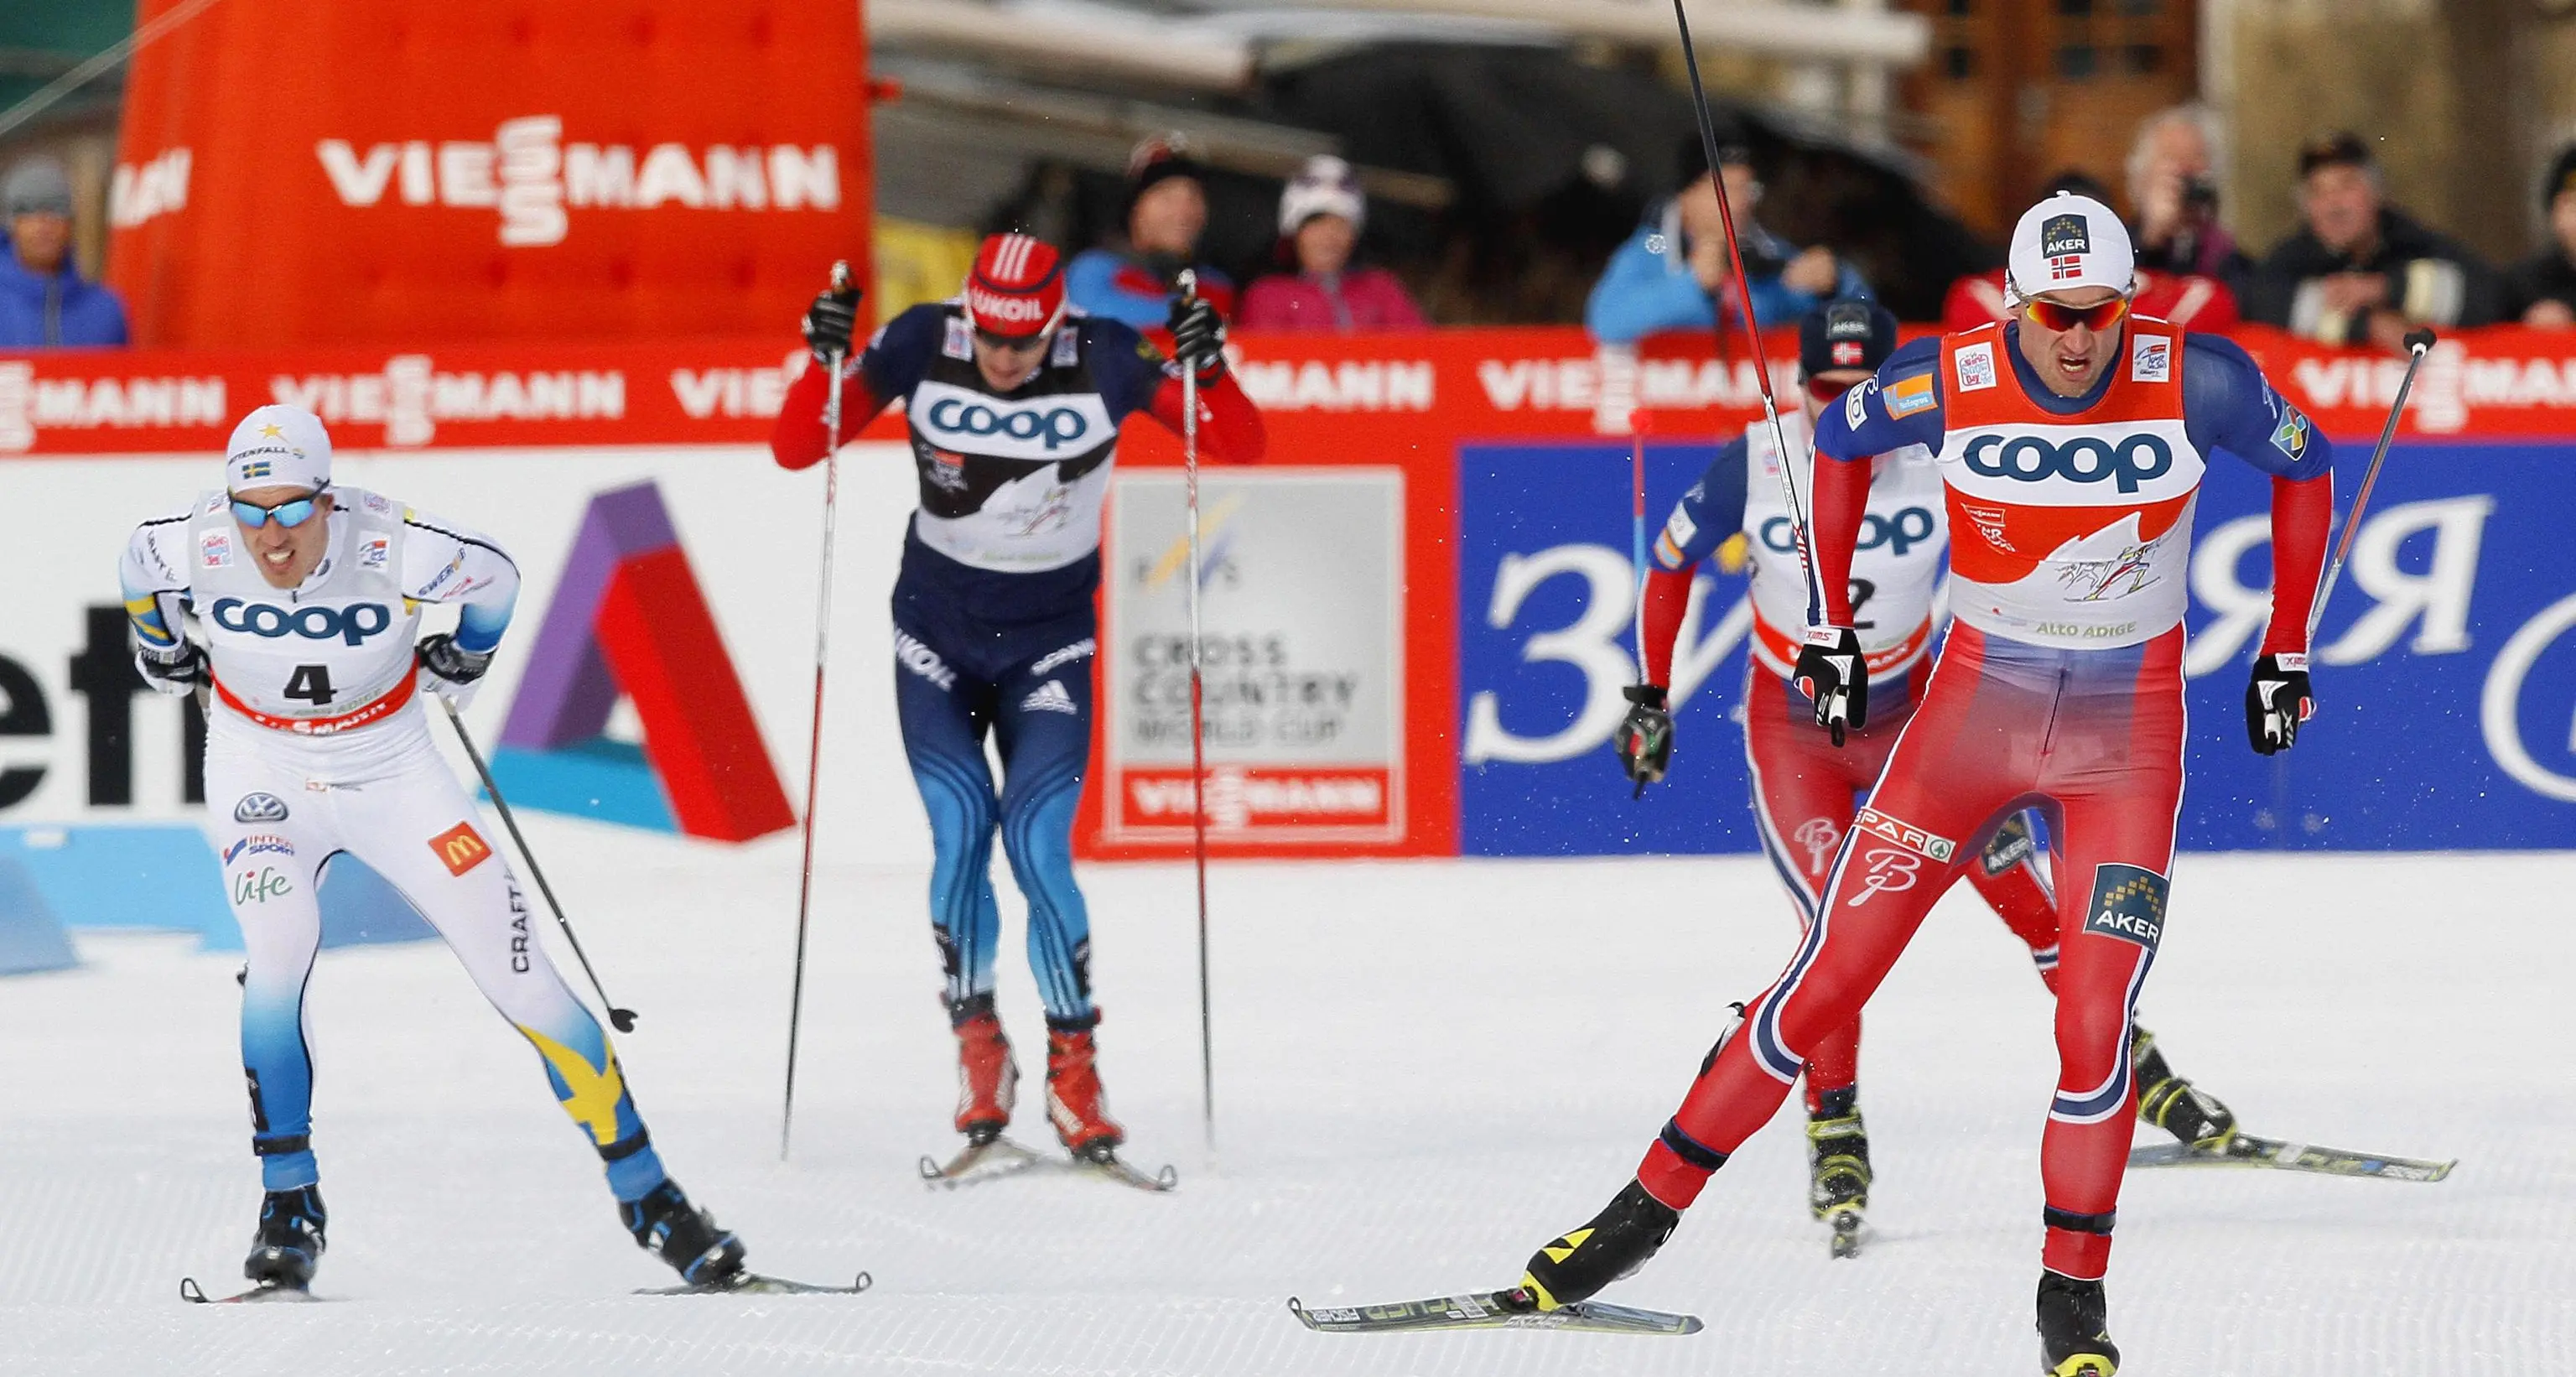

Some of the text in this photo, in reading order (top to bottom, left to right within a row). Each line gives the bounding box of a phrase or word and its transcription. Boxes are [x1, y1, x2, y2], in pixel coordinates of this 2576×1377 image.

[316, 115, 839, 246] VIESSMANN
[2046, 238, 2086, 254] AKER
[2083, 621, 2137, 638] ADIGE
[283, 665, 338, 706] 4
[1854, 809, 1925, 850] SPAR
[235, 866, 293, 907] life
[508, 885, 531, 974] CRAFT
[2095, 910, 2160, 944] AKER
